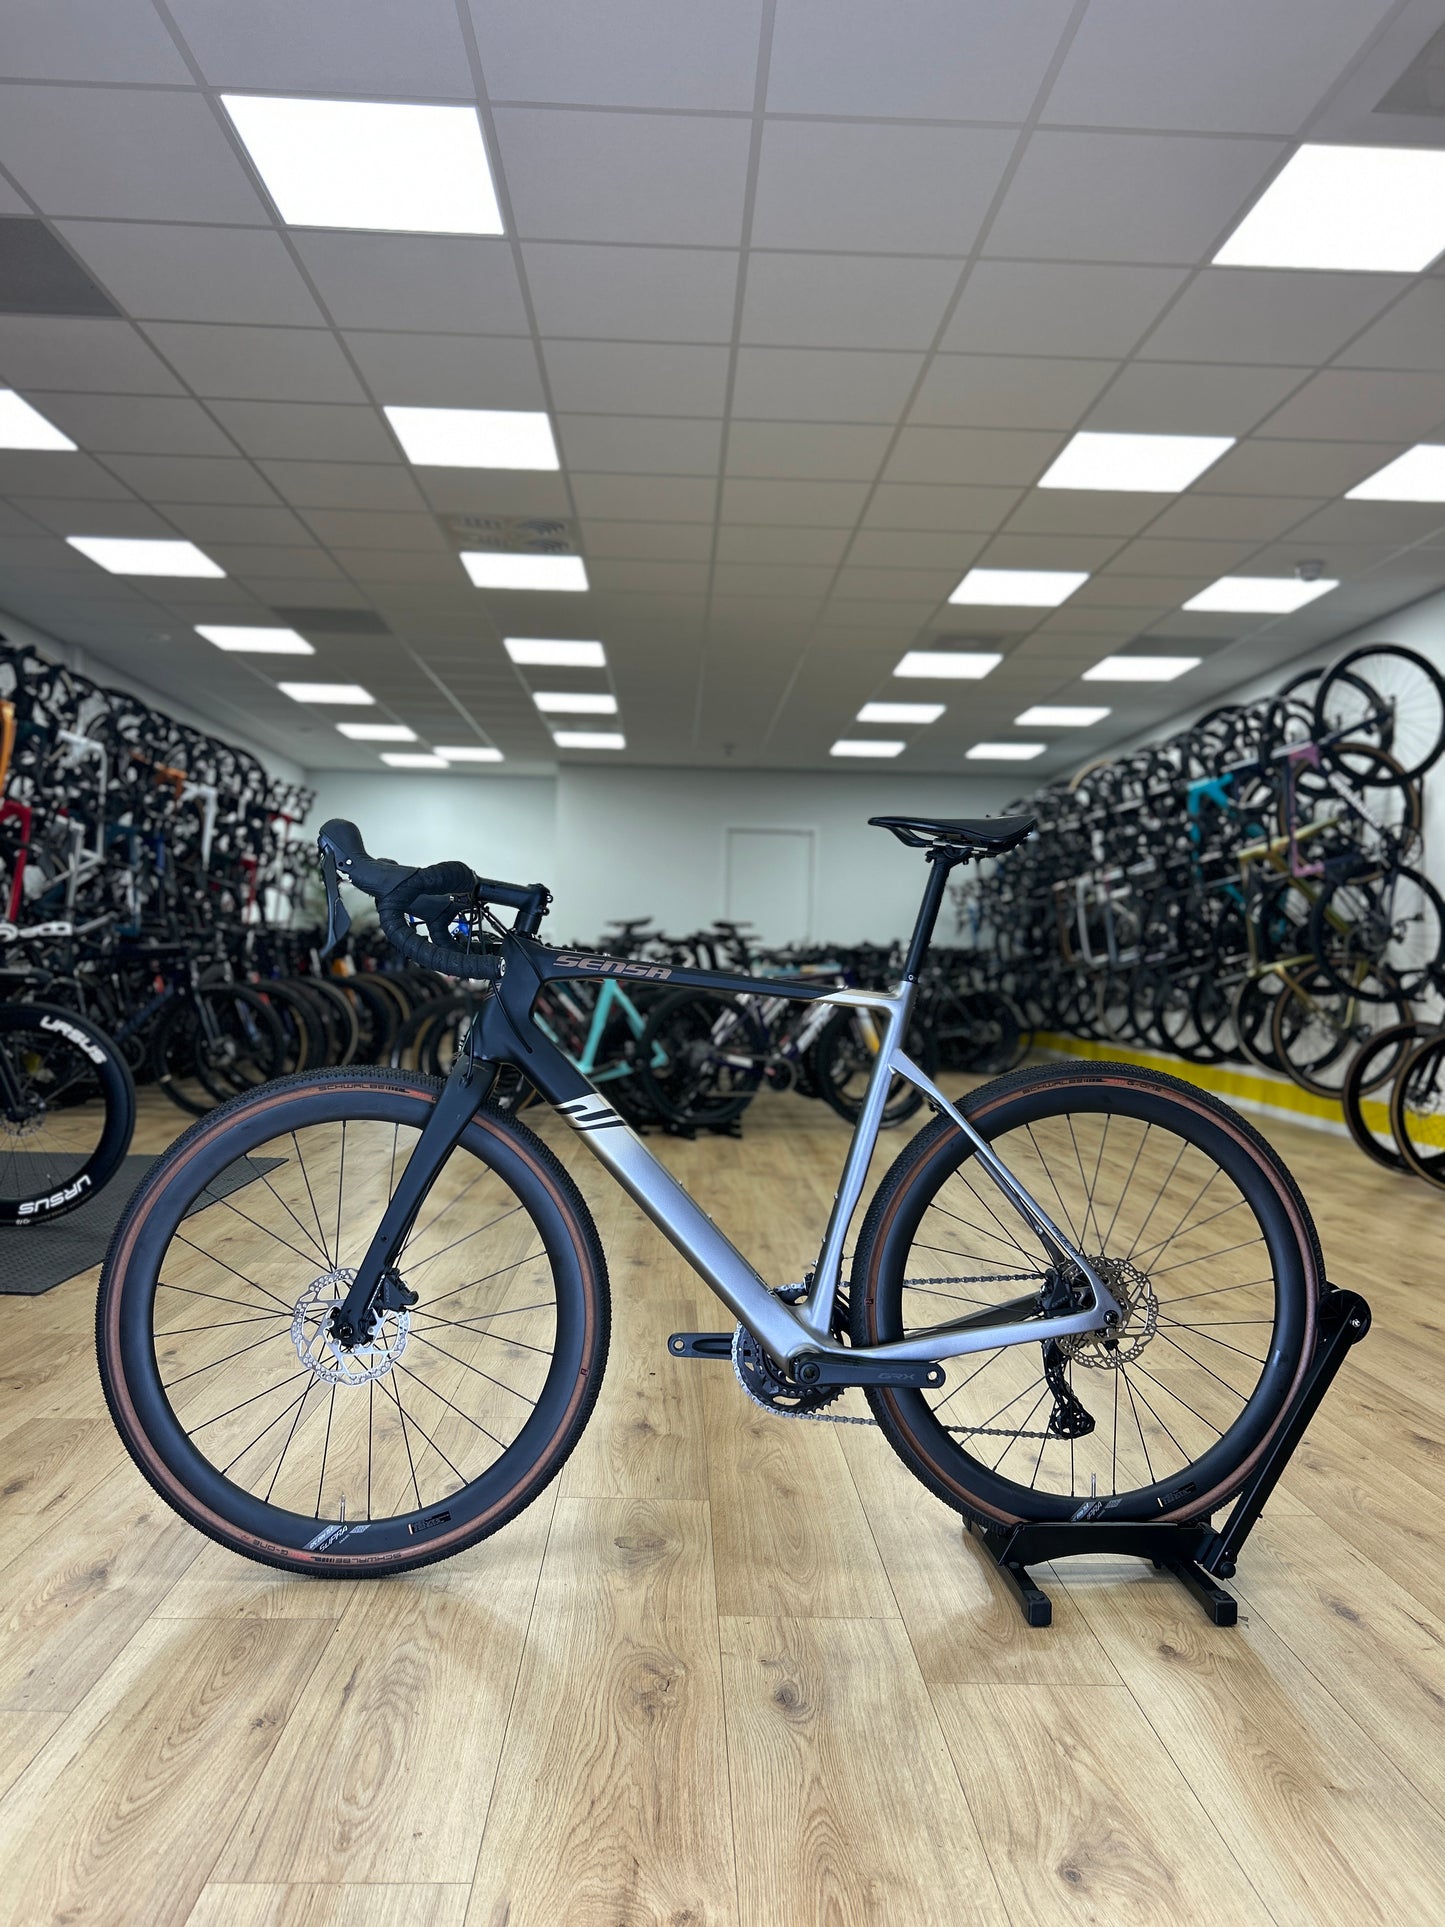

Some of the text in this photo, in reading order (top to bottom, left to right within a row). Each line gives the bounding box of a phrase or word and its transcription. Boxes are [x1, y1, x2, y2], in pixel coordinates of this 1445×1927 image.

[553, 955, 672, 980] SENSA
[40, 1015, 107, 1065] URSUS
[318, 1082, 384, 1092] SCHWALBE
[1021, 1077, 1083, 1095] SCHWALBE
[18, 1174, 92, 1215] URSUS
[878, 1372, 915, 1381] GRX
[319, 1525, 349, 1552] SUPRA
[335, 1553, 402, 1565] SCHWALBE
